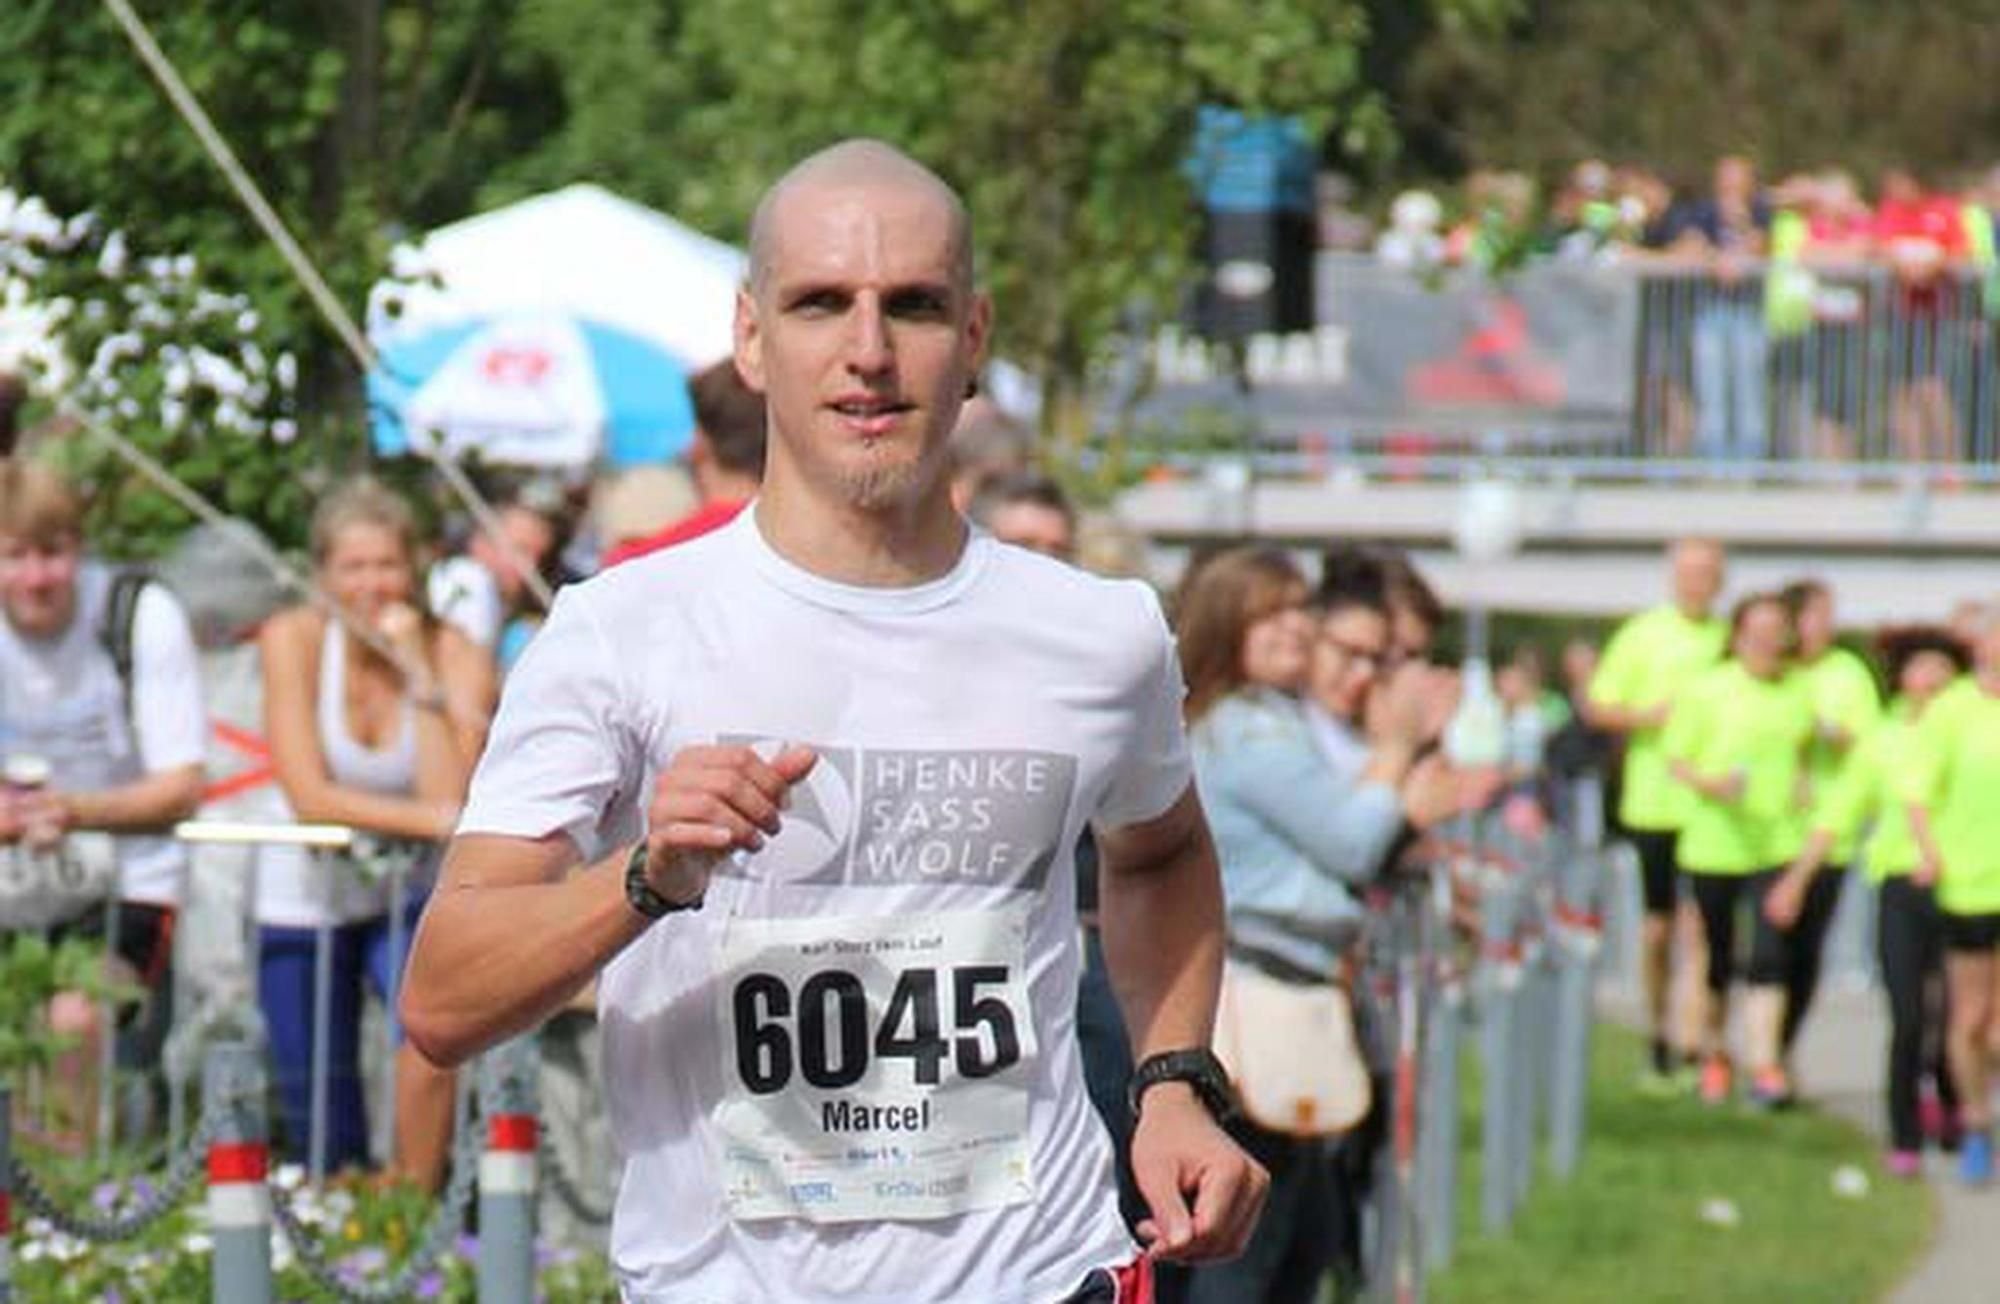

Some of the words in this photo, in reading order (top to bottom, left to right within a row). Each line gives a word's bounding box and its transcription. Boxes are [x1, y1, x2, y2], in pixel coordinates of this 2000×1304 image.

[876, 757, 1049, 793] HENKE
[872, 799, 993, 833] SASS
[866, 842, 1011, 878] WOLF
[733, 965, 1020, 1095] 6045
[822, 1099, 929, 1132] Marcel
